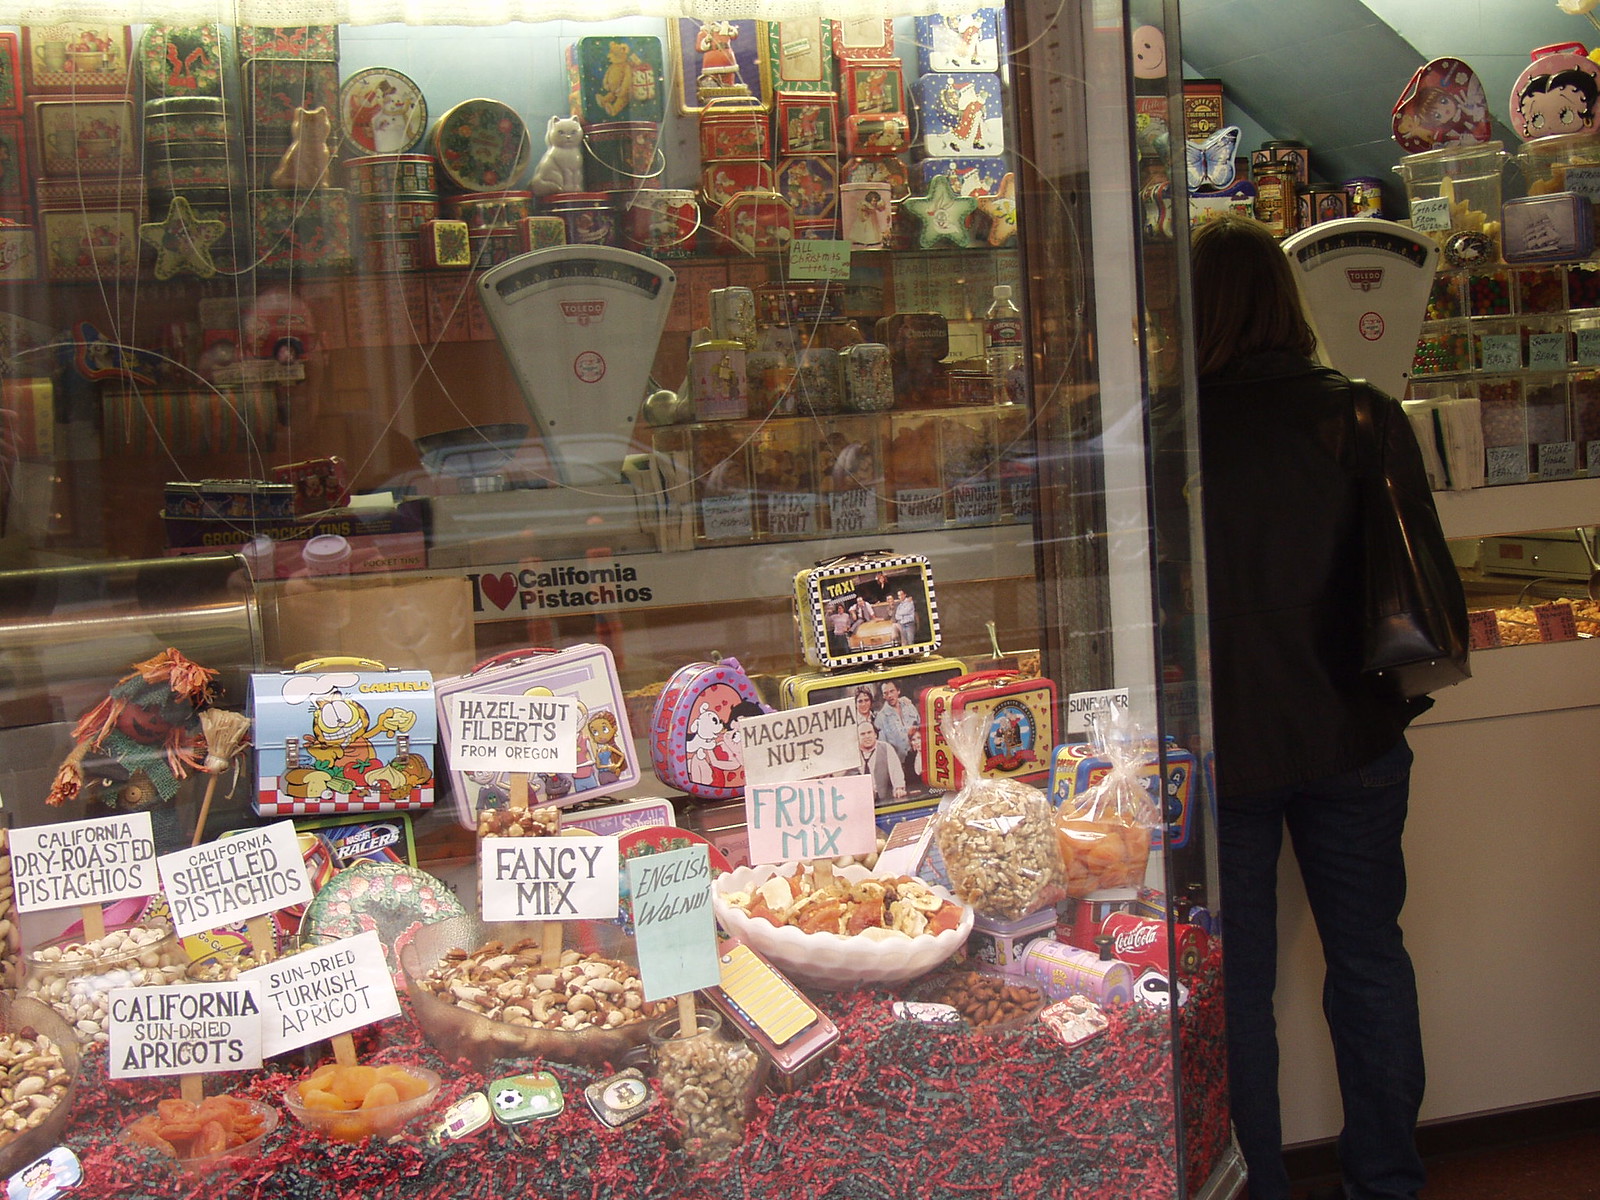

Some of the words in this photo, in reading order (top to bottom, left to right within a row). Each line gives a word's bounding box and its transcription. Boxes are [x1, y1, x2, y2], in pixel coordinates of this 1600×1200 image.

[793, 241, 812, 253] ALL
[1350, 272, 1380, 280] TOLEDO
[565, 304, 601, 313] TOLEDO
[954, 485, 998, 503] NATURAL
[319, 521, 350, 536] TINS
[518, 564, 637, 588] California
[826, 579, 855, 597] TAXI
[468, 573, 484, 612] I
[519, 585, 652, 611] Pistachios
[359, 681, 431, 693] GARFIELD
[459, 701, 570, 722] HAZEL-NUT
[461, 721, 557, 743] FILBERTS
[743, 710, 857, 749] MACADAMIA
[461, 744, 498, 759] FROM
[505, 744, 559, 760] OREGON
[767, 740, 825, 767] NUTS
[37, 822, 132, 848] CALIFORNIA
[621, 816, 665, 831] Sabrina
[188, 833, 273, 865] CALIFORNIA
[338, 830, 400, 859] RACERS
[346, 831, 372, 846] NASCAR
[14, 838, 155, 877] DRY-ROASTED
[496, 846, 604, 881] FANCY
[172, 847, 279, 896] SHELLED
[18, 864, 142, 906] PISTACHIOS
[176, 868, 301, 925] PISTACHIOS
[516, 881, 579, 917] MIX
[198, 932, 209, 943] Go
[270, 950, 356, 988] SUN-DRIED
[267, 974, 358, 1012] TURKISH
[112, 990, 259, 1023] CALIFORNIA
[281, 986, 370, 1037] APRICOT
[134, 1021, 231, 1039] SUN-DRIED
[121, 1039, 244, 1071] APRICOTS
